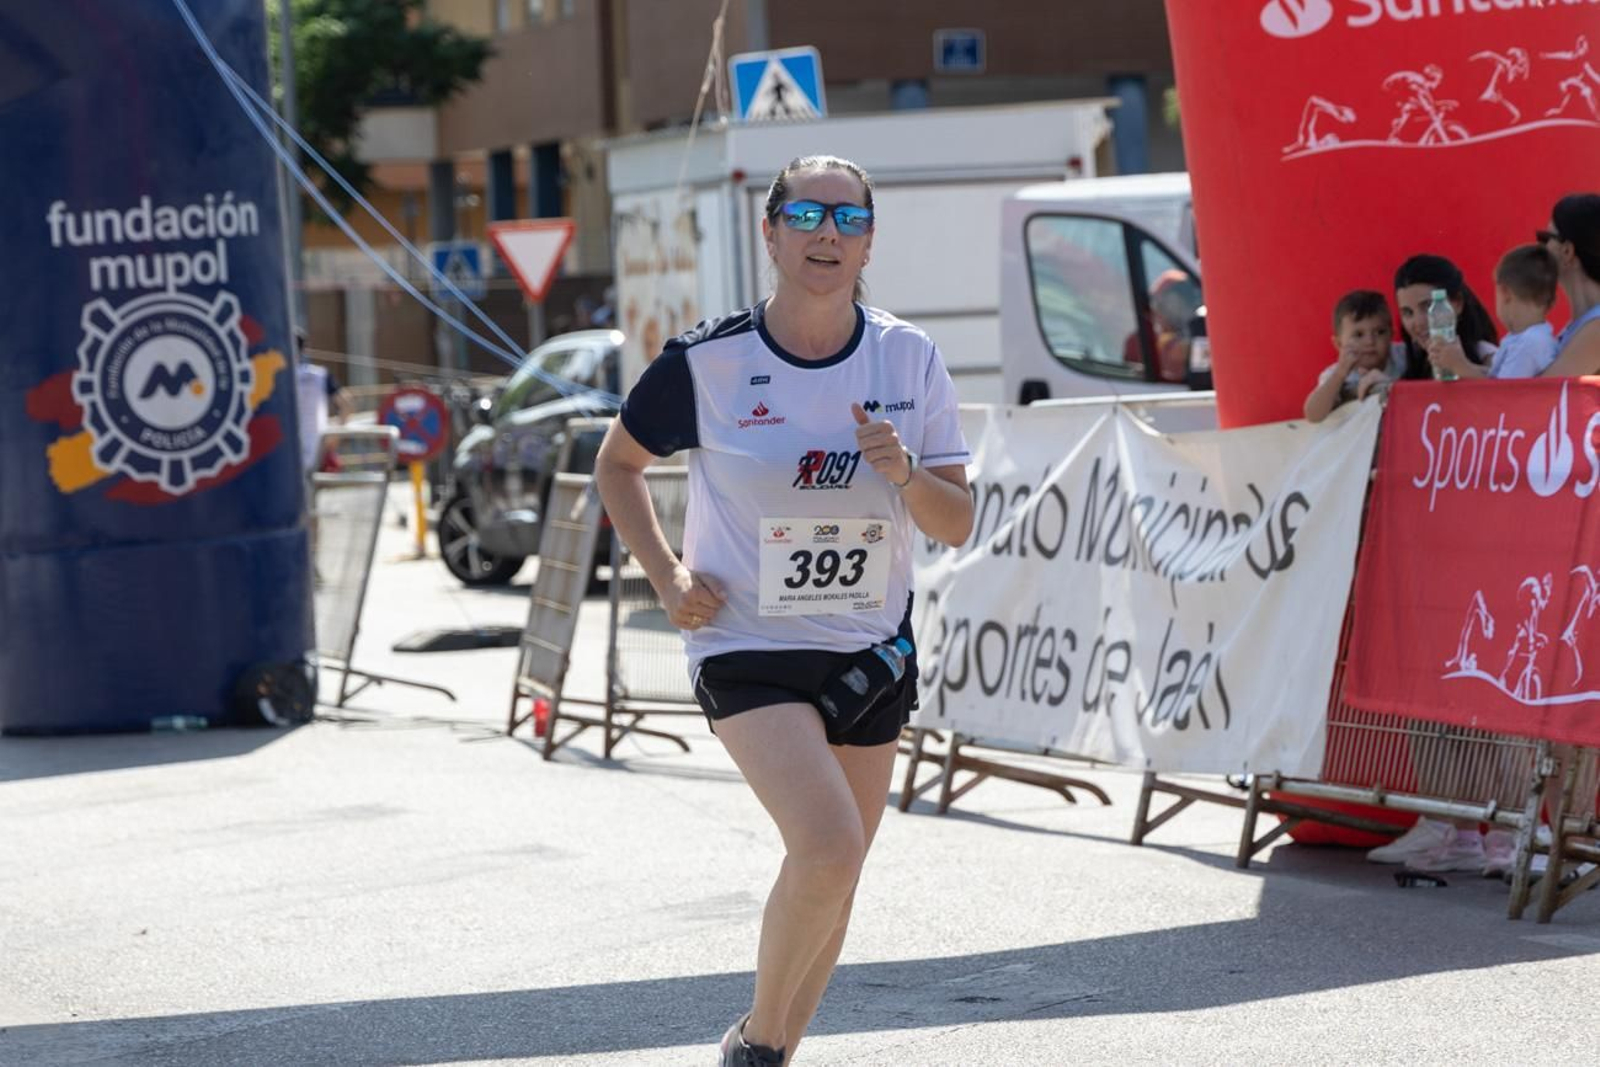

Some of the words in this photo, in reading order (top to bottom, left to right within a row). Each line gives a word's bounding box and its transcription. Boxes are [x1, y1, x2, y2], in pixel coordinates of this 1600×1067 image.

[46, 191, 259, 247] fundación
[89, 238, 229, 294] mupol
[738, 416, 786, 429] Santander
[1413, 403, 1526, 513] Sports
[1574, 411, 1600, 498] S
[784, 549, 868, 589] 393
